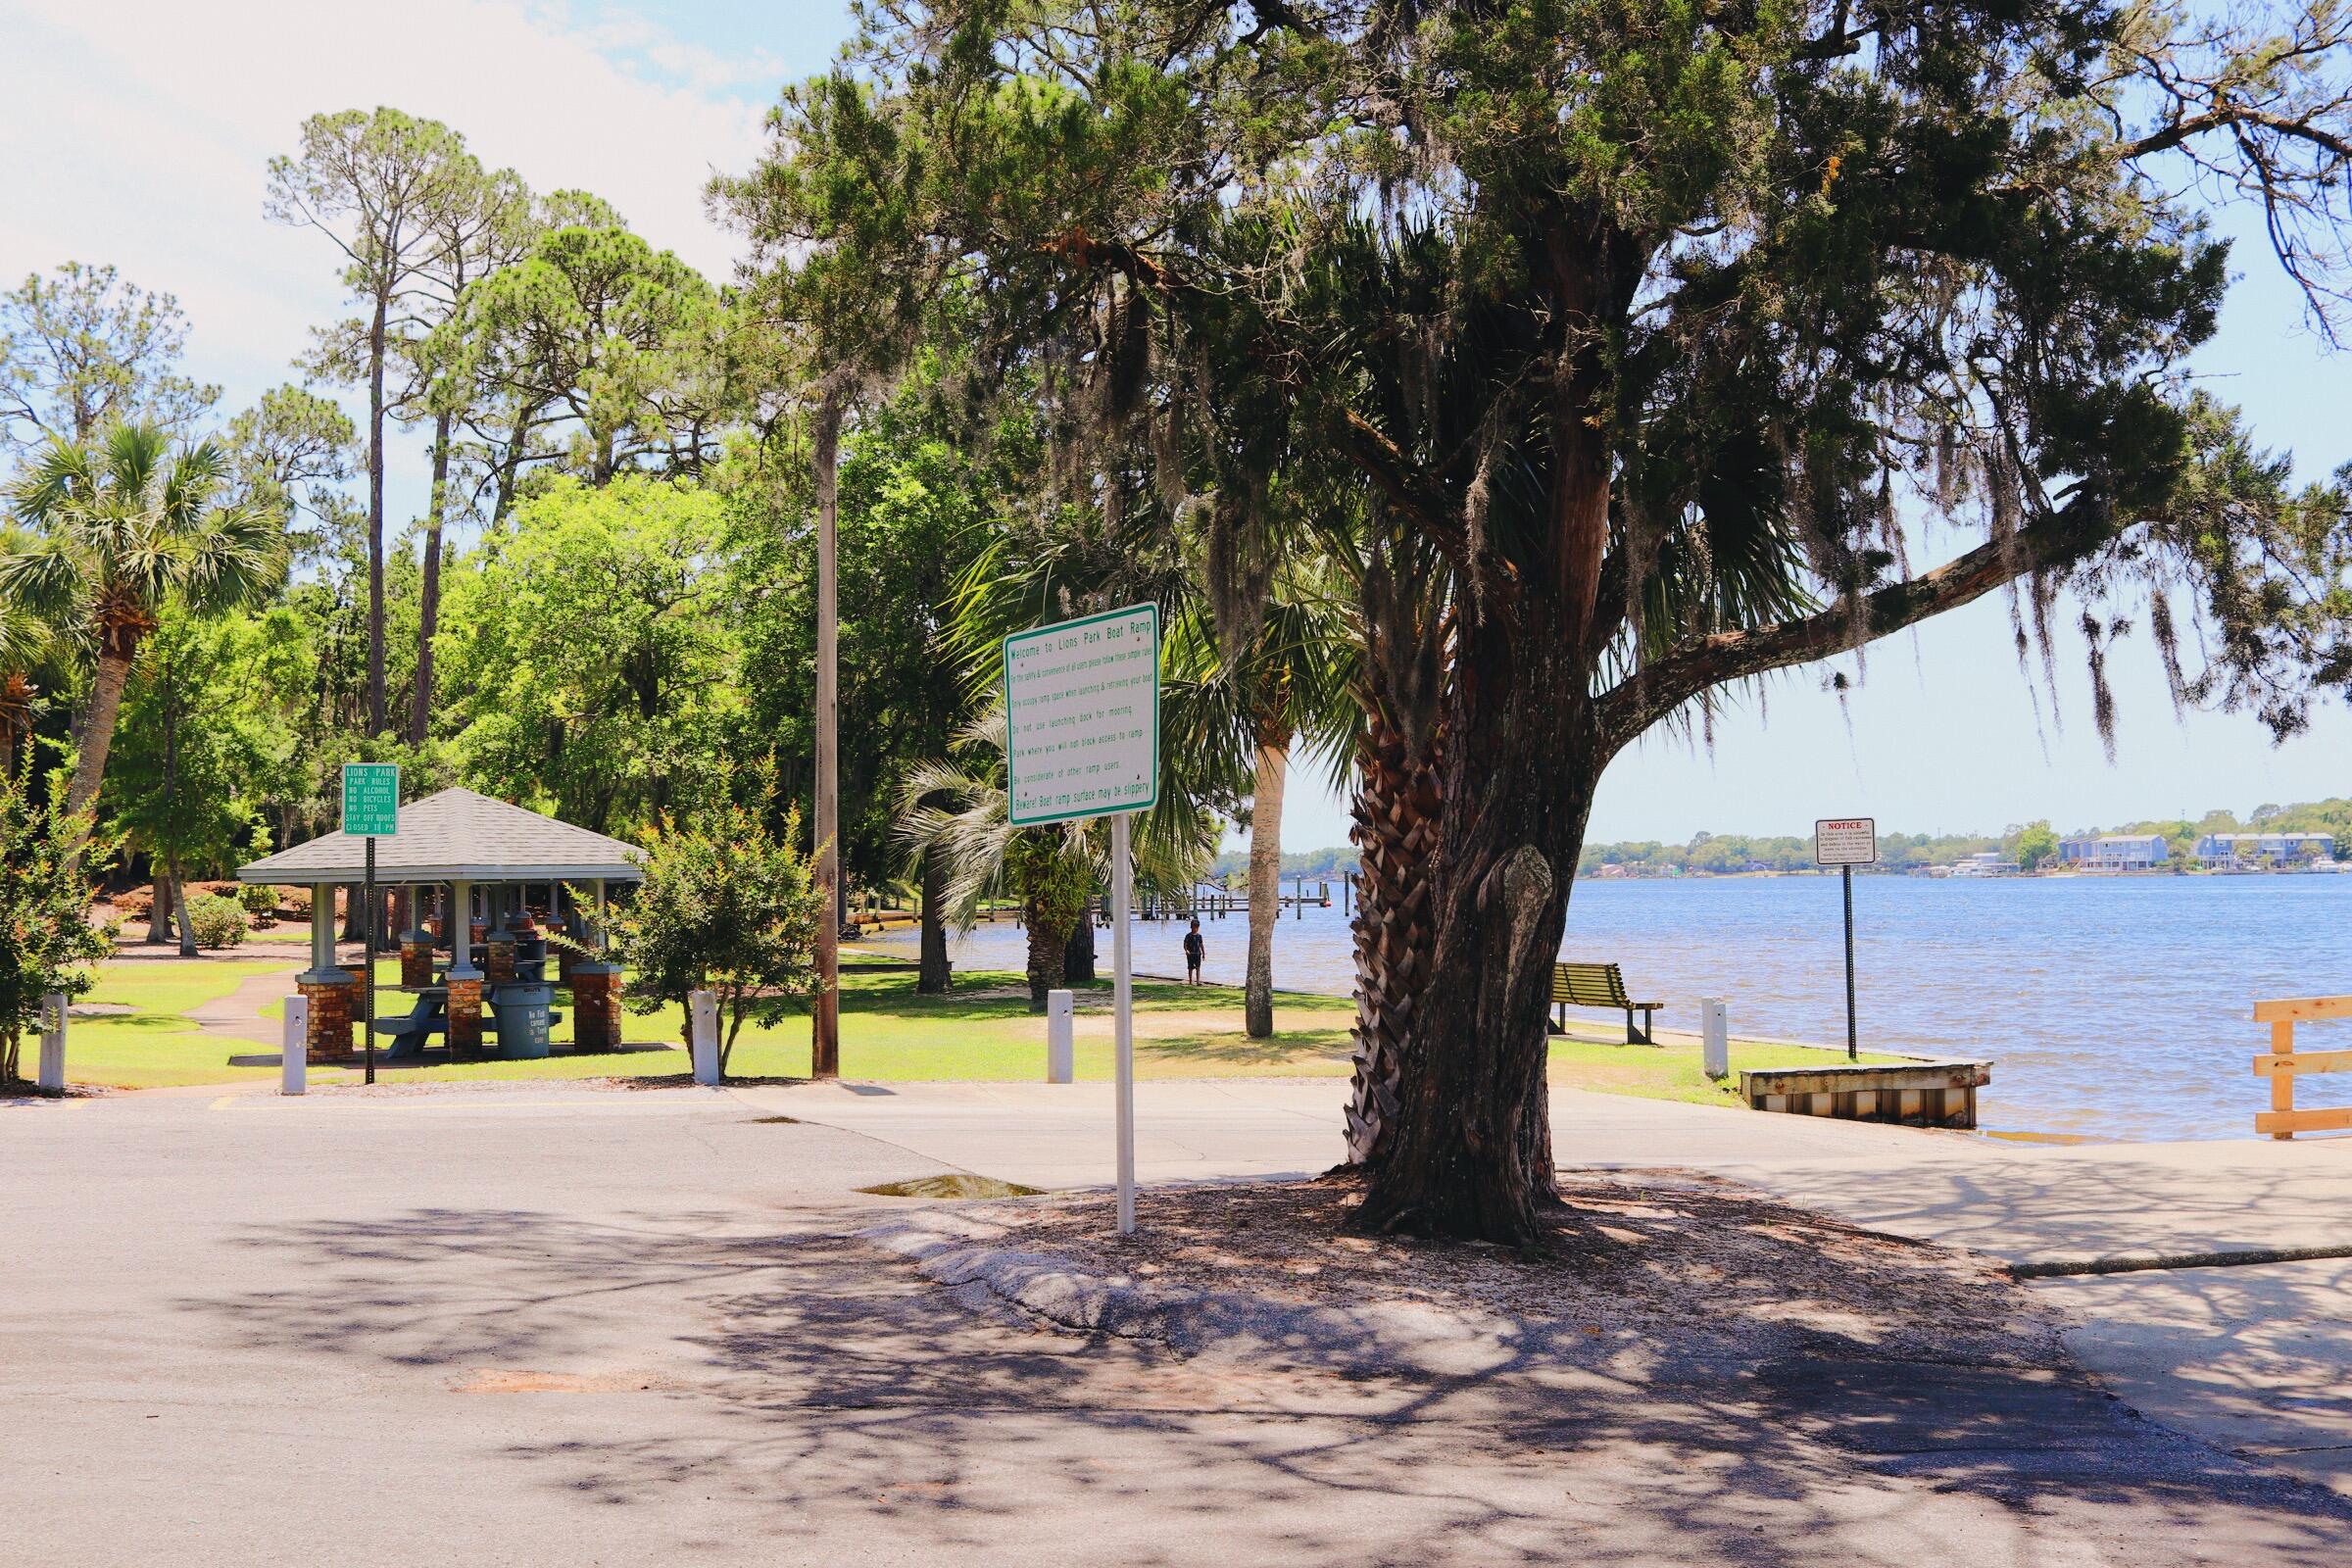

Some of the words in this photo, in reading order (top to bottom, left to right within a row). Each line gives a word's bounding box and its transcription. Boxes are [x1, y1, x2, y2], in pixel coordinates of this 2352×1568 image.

[1011, 645, 1039, 660] Welcome
[1045, 643, 1052, 652] to
[1059, 639, 1078, 650] Lions
[1084, 632, 1101, 644] Park
[1107, 625, 1123, 638] Boat
[1130, 621, 1151, 634] Ramp
[1042, 666, 1065, 677] convenience
[1077, 660, 1087, 670] users
[1089, 658, 1101, 669] please
[1102, 655, 1114, 664] follow
[1115, 652, 1126, 661] these
[1128, 649, 1140, 659] simple
[1142, 647, 1152, 656] rules
[1023, 697, 1037, 706] occupy
[1040, 694, 1049, 705] ramp
[1052, 691, 1064, 702] space
[1066, 689, 1076, 697] when
[1079, 683, 1099, 695] launching
[1101, 682, 1105, 690] &
[1107, 678, 1128, 689] retrieving
[1131, 676, 1141, 687] your
[1142, 673, 1152, 683] boat
[1013, 725, 1019, 735] Do
[1037, 721, 1045, 730] use
[1050, 716, 1075, 728] launching
[1080, 712, 1091, 722] dock
[1014, 748, 1024, 758] Park
[1028, 746, 1042, 756] where
[1046, 745, 1055, 755] you
[1058, 741, 1066, 751] will
[1070, 739, 1078, 748] not
[1082, 736, 1095, 746] block
[1098, 733, 1116, 744] access
[1119, 731, 1125, 740] to
[1129, 729, 1143, 739] ramp
[347, 768, 368, 776] LIONS
[376, 768, 396, 776] PARK
[1014, 776, 1020, 784] Be
[1024, 771, 1054, 784] considerate
[1058, 769, 1063, 778] of
[1068, 766, 1082, 777] other
[1086, 763, 1100, 774] ramp
[1016, 795, 1037, 811] Beware!
[1040, 795, 1052, 807] Boat
[1056, 793, 1070, 806] ramp
[1074, 790, 1094, 803] surface
[1098, 788, 1111, 800] may
[1115, 785, 1121, 796] be
[1124, 782, 1149, 798] slippery
